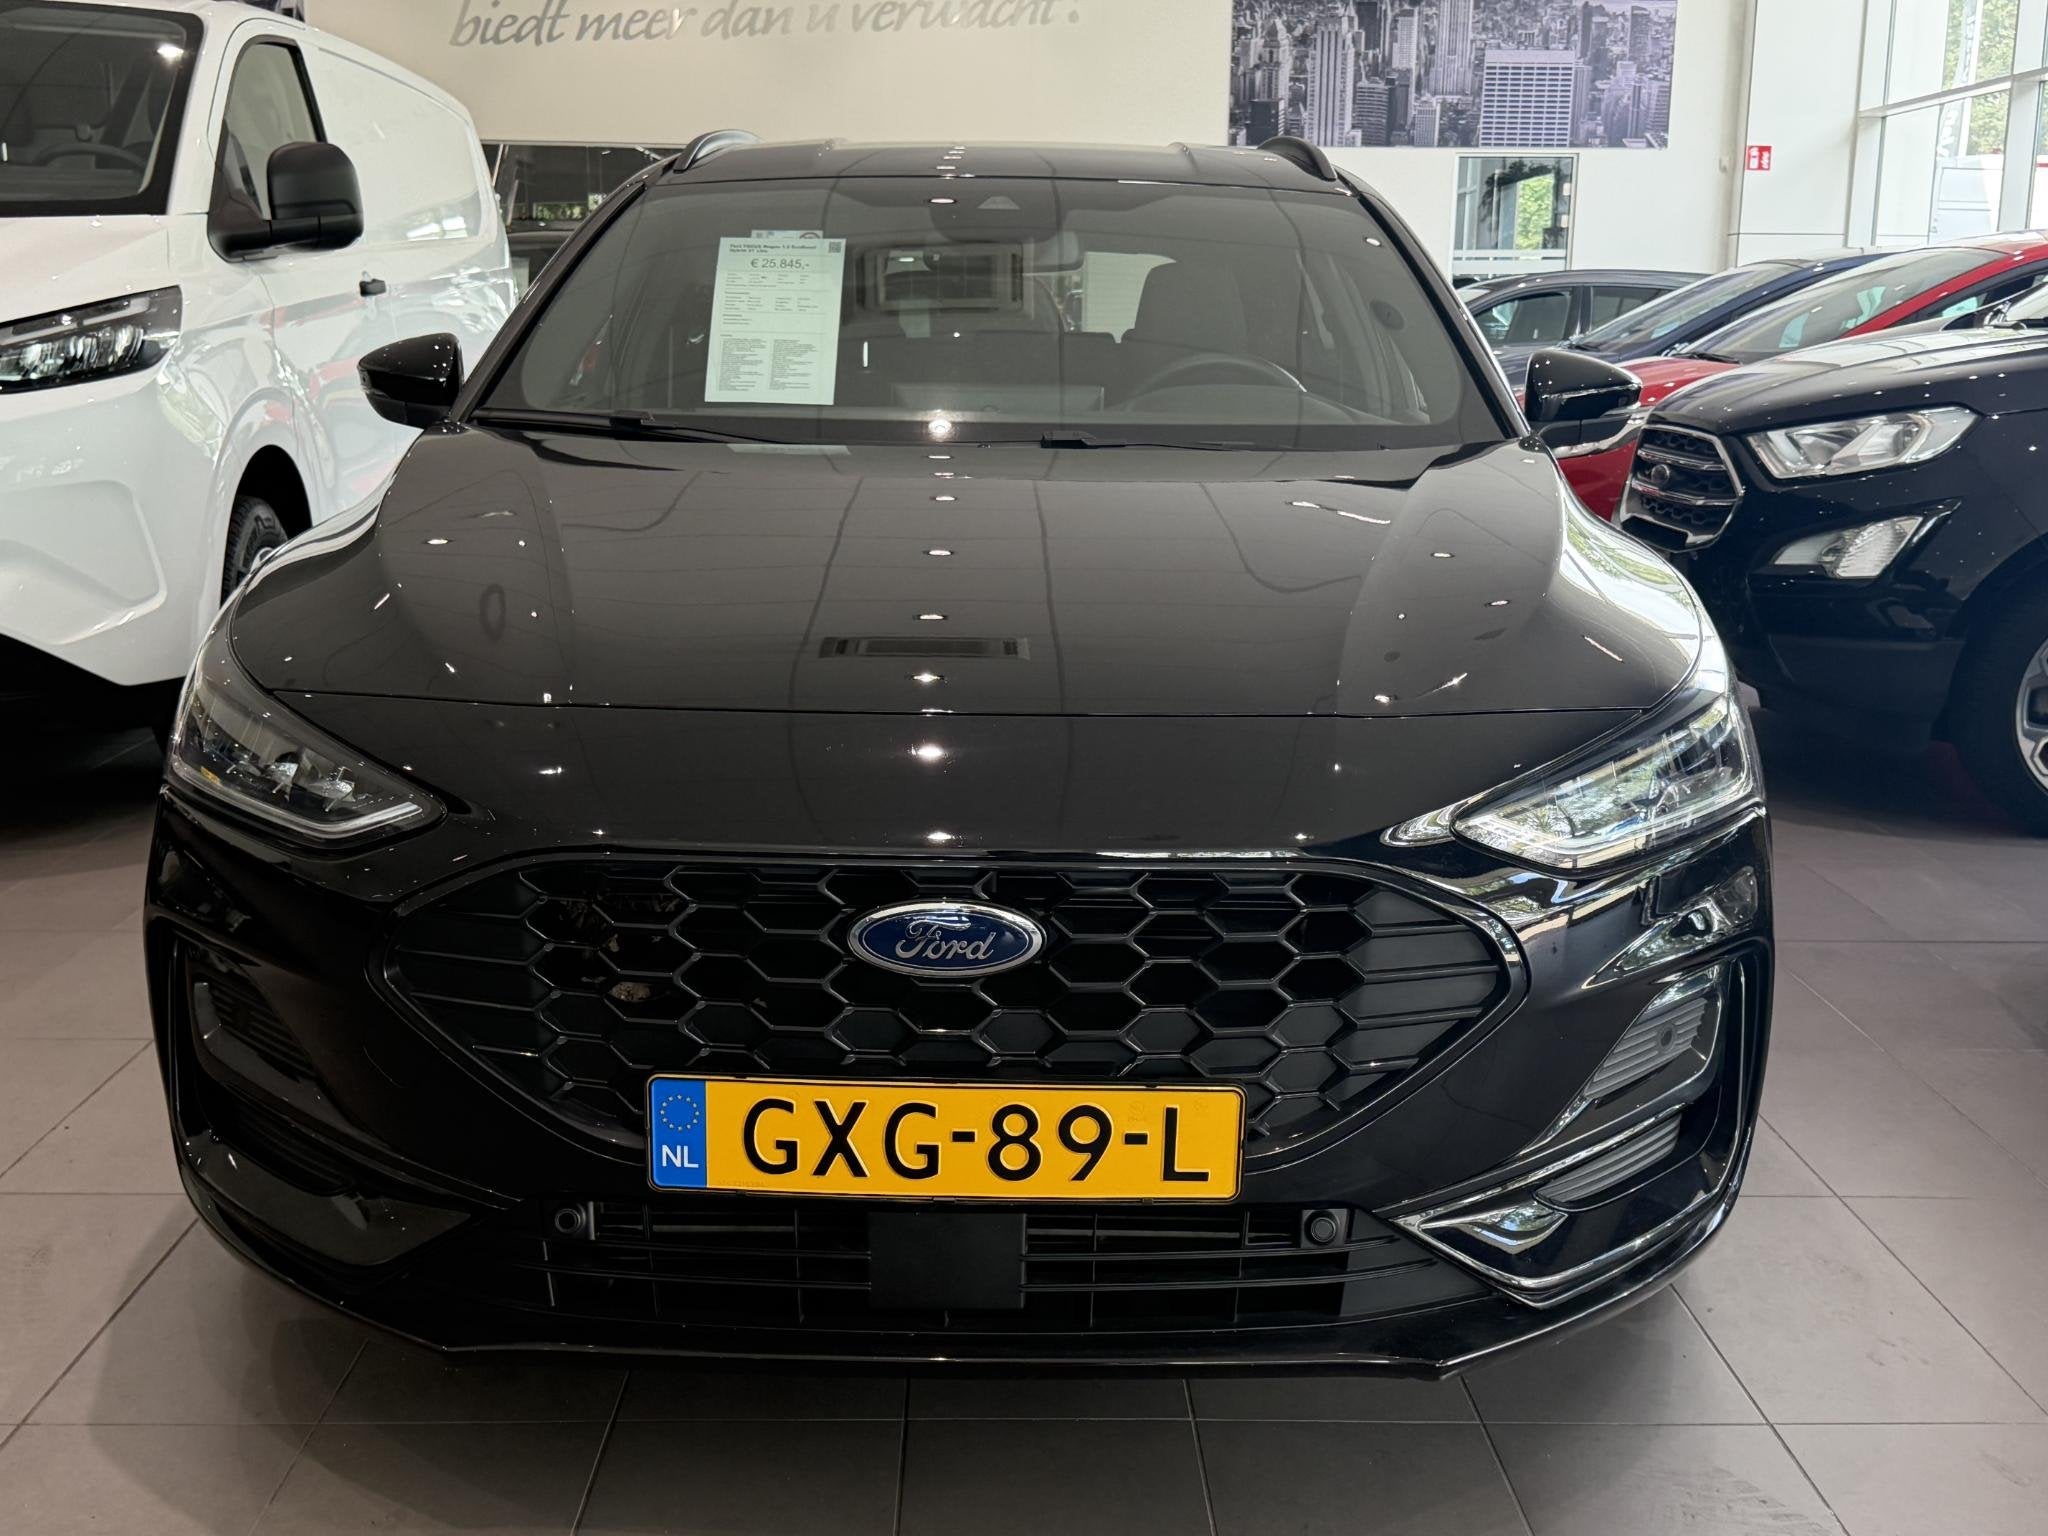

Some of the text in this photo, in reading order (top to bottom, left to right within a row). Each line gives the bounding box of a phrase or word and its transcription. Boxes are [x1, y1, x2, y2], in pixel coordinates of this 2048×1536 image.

[449, 0, 1079, 47] biedt meer dan u verwacht
[750, 258, 759, 269] €
[895, 918, 996, 960] Ford
[661, 1144, 700, 1169] NL
[742, 1097, 1211, 1183] GXG-89-L
